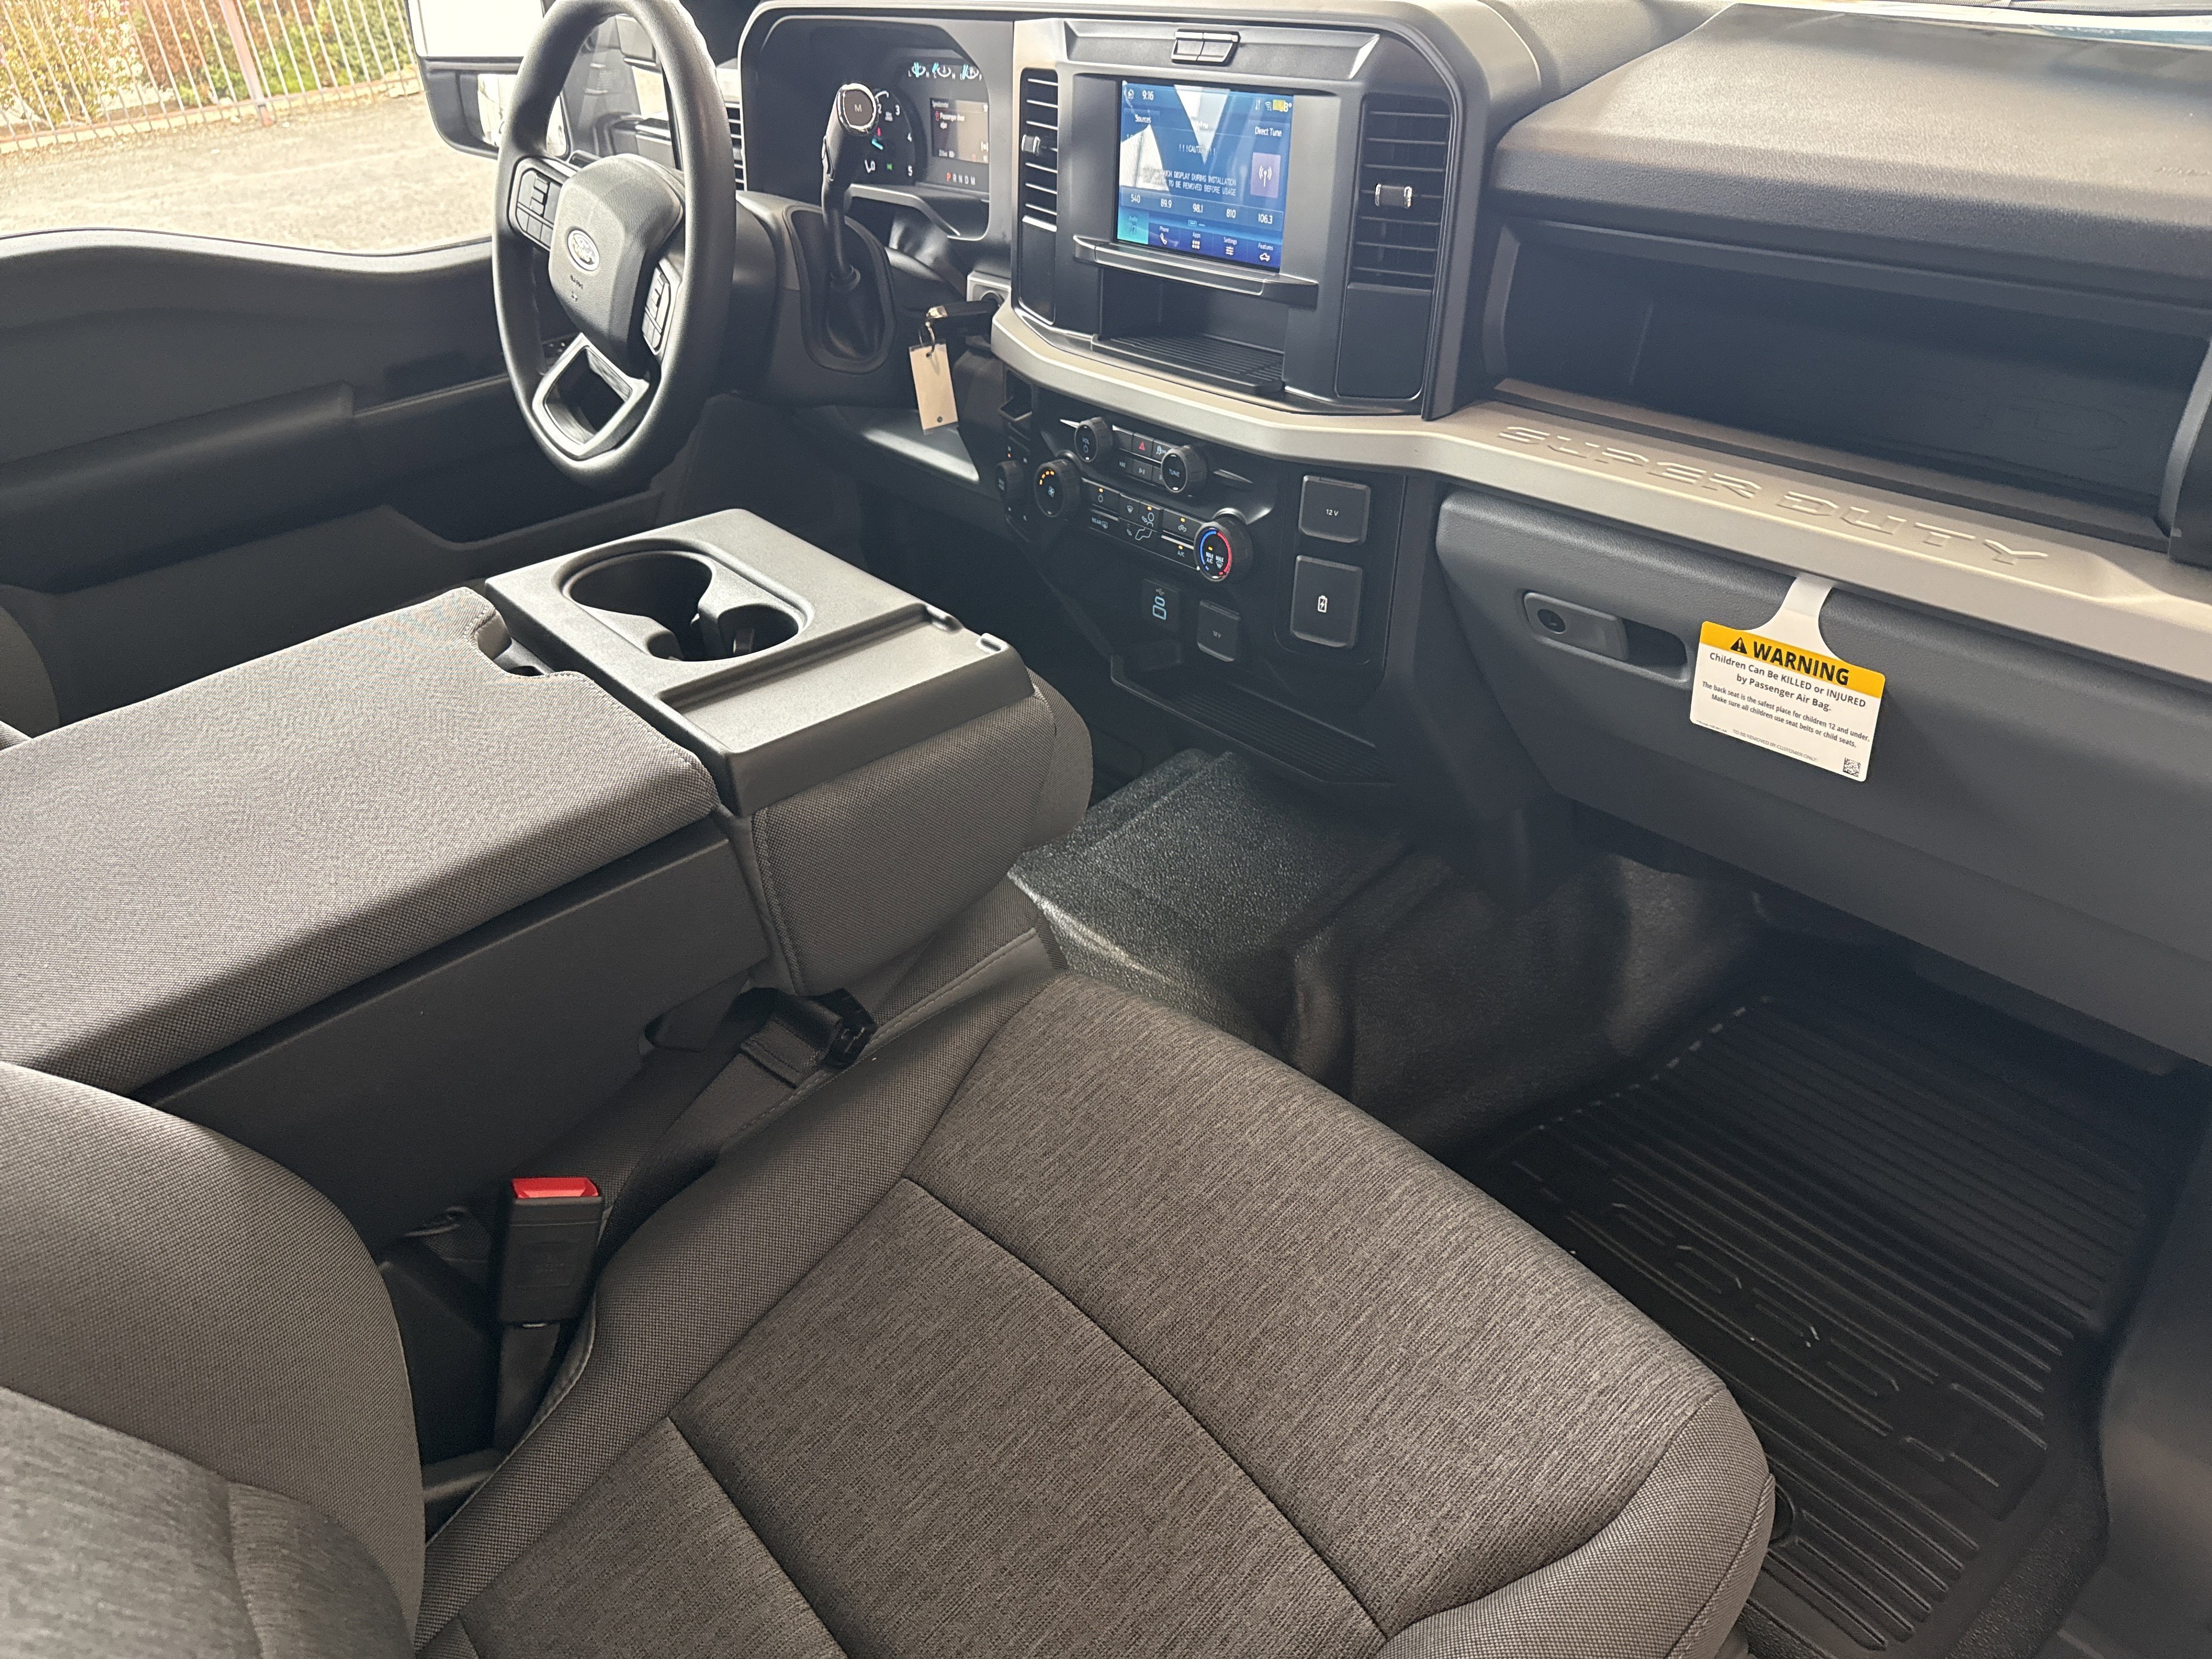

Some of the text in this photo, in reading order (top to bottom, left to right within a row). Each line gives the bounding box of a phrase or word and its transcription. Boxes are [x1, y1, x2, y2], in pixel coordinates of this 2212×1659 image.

[1142, 90, 1154, 100] 9:16
[854, 104, 862, 112] M
[895, 104, 900, 115] 3
[1135, 115, 1152, 123] Sources
[1255, 127, 1282, 137] Direct Tune
[907, 133, 912, 142] 4
[908, 165, 913, 176] 5
[946, 172, 952, 182] P
[1174, 171, 1190, 180] DISPLAY
[1191, 173, 1207, 183] DURING
[1208, 176, 1237, 187] INSTALLATION
[1175, 180, 1182, 189] BE
[1183, 182, 1202, 191] REMOVED
[1204, 185, 1221, 194] BEFORE
[1222, 188, 1237, 196] USAGE
[1130, 194, 1141, 204] 540
[1160, 198, 1172, 209] 89.9
[1192, 203, 1203, 213] 98.1
[1226, 208, 1236, 218] 810
[1258, 213, 1273, 224] 106.3
[1223, 236, 1238, 245] Settings
[1258, 242, 1273, 251] Features
[1169, 469, 1180, 478] TUNE
[1497, 426, 2049, 566] SUPER DUTY
[1092, 517, 1102, 525] REAR
[1753, 641, 1850, 686] WARNING
[1709, 652, 1866, 707] Children Can Be KILLED or INJURED
[1736, 673, 1832, 712] by Passenger Air Bag.
[1702, 681, 1712, 690] The
[1713, 684, 1726, 695] back
[1728, 690, 1740, 698] seat
[1747, 695, 1756, 704] the
[1758, 699, 1775, 710] safest
[1775, 705, 1791, 716] place
[1792, 710, 1801, 719] for
[1802, 714, 1827, 727] children
[1837, 725, 1848, 735] and
[1850, 730, 1870, 742] under.
[1711, 693, 1727, 704] Make
[1728, 700, 1740, 708] sure
[1750, 706, 1773, 720] children
[1774, 715, 1785, 724] use
[1785, 719, 1798, 728] seat
[1799, 723, 1814, 733] belts
[1823, 731, 1838, 741] child
[1839, 736, 1857, 748] seats.
[1747, 733, 1769, 746] REMOVED
[1776, 744, 1803, 758] CUSTOMER
